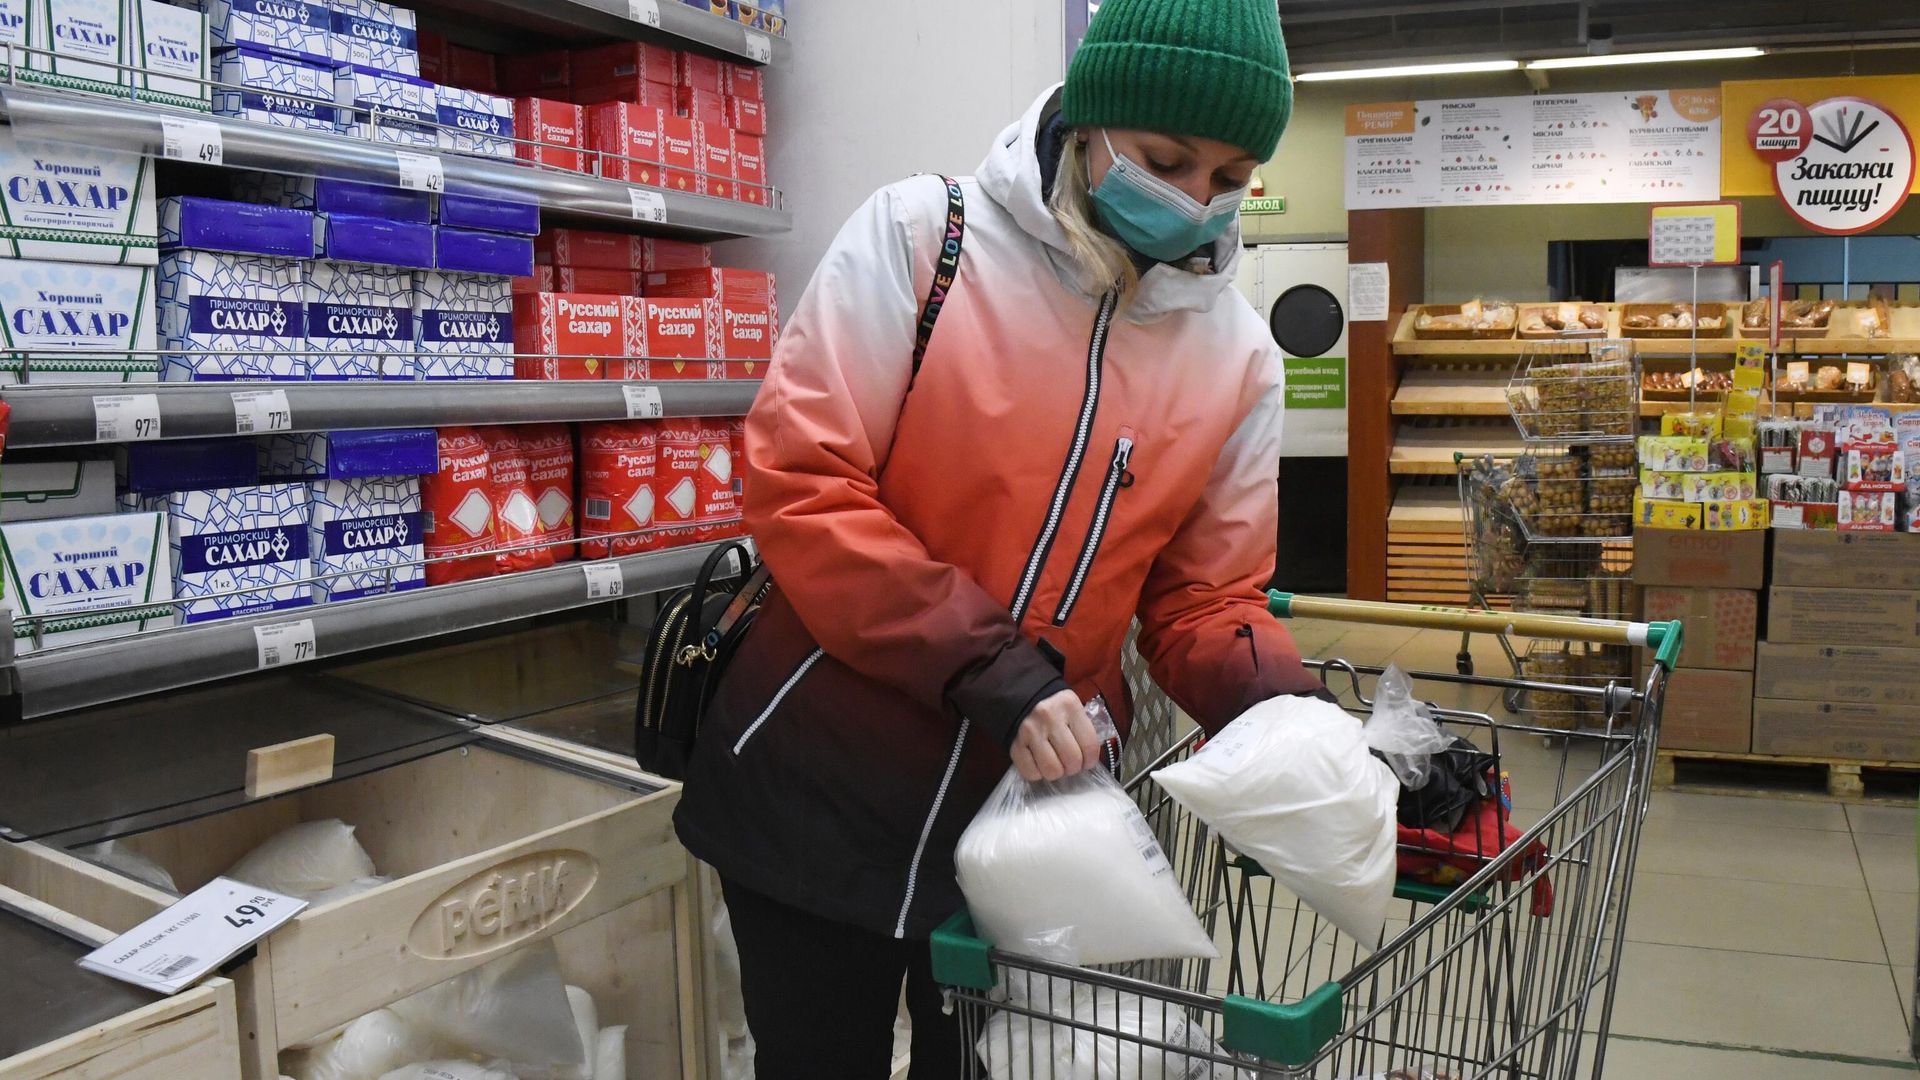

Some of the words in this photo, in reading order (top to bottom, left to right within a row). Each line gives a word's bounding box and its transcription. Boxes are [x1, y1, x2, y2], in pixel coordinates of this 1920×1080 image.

[256, 1, 297, 20] САХАР
[56, 24, 116, 47] САХАР
[352, 24, 389, 42] САХАР
[148, 42, 200, 64] САХАР
[1441, 102, 1476, 110] РИМСКАЯ
[456, 115, 490, 131] САХАР
[541, 122, 574, 136] Русский
[1758, 108, 1801, 135] 20
[547, 133, 570, 143] сахар
[629, 127, 656, 140] Русский
[665, 136, 691, 148] Русский
[199, 143, 214, 161] 49
[707, 143, 729, 156] Русский
[1757, 137, 1799, 150] минут
[33, 159, 101, 177] Хороший
[1791, 157, 1894, 181] Закажи
[426, 174, 438, 191] 42
[8, 176, 128, 210] САХАР
[1797, 183, 1882, 212] пищу!
[1240, 199, 1280, 210] ВЫХОД
[941, 211, 963, 267] LOVE
[38, 291, 103, 305] Хороший
[210, 299, 269, 312] ПРИМОРСКИЙ
[922, 273, 952, 329] LOVE
[327, 306, 383, 317] ПРИМОРСКИЙ
[439, 312, 486, 322] ПРИМОРСКИЙ
[558, 299, 619, 319] Русский
[648, 303, 702, 321] Русский
[724, 308, 768, 326] Русский
[13, 308, 129, 337] САХАР
[211, 310, 270, 331] САХАР
[328, 316, 383, 334] САХАР
[439, 321, 487, 338] САХАР
[568, 320, 612, 337] сахар
[658, 323, 695, 338] сахар
[732, 327, 763, 342] сахар
[136, 419, 150, 437] 97
[268, 412, 282, 429] 77
[452, 467, 487, 482] сахар
[531, 467, 568, 481] сахар
[342, 517, 394, 530] ПРИМОРСКИЙ
[204, 529, 270, 546] ПРИМОРСКИЙ
[343, 528, 394, 549] САХАР
[53, 546, 118, 564] Хороший
[205, 540, 271, 566] САХАР
[29, 562, 144, 598] САХАР
[609, 581, 618, 595] 63
[232, 604, 274, 616] КЛАССИЧЕСКИЙ
[294, 642, 308, 660] 77
[223, 904, 266, 929] 49
[249, 895, 266, 904] 90
[113, 932, 166, 964] САХАР-ПЕСОК
